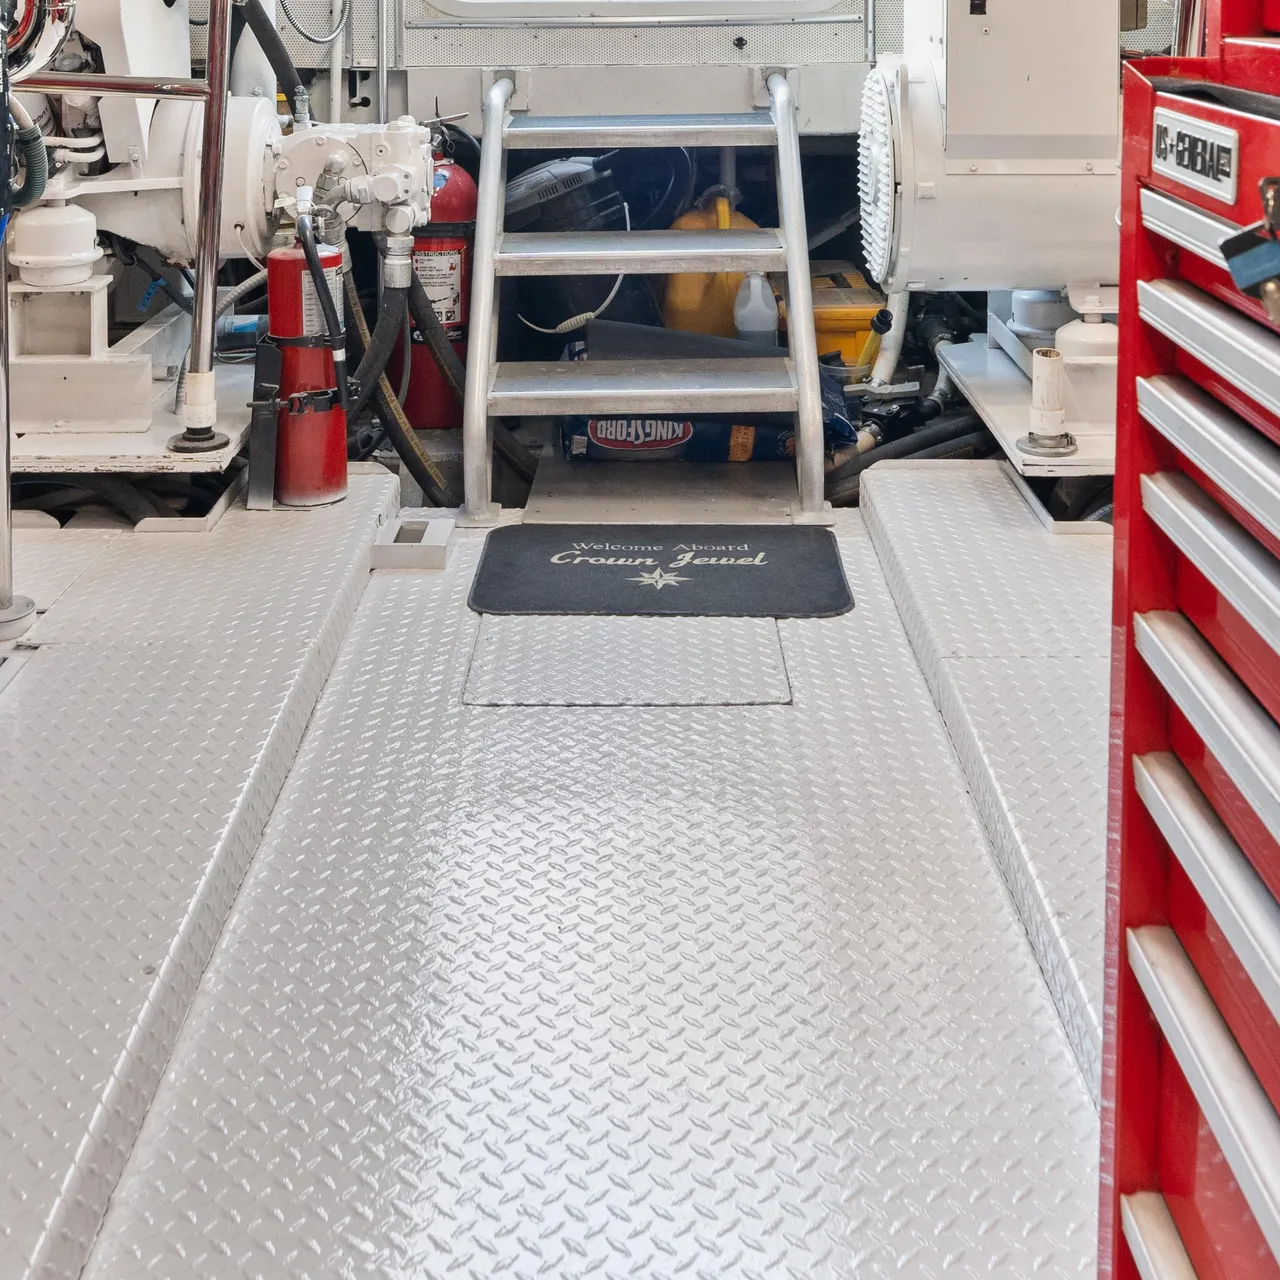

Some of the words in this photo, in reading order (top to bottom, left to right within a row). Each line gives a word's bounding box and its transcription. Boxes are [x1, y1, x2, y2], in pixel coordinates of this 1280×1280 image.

[597, 420, 684, 445] KINGSFORD
[572, 542, 664, 552] Welcome
[672, 543, 750, 552] Aboard
[550, 550, 659, 566] Crown
[669, 551, 769, 568] Jewel
